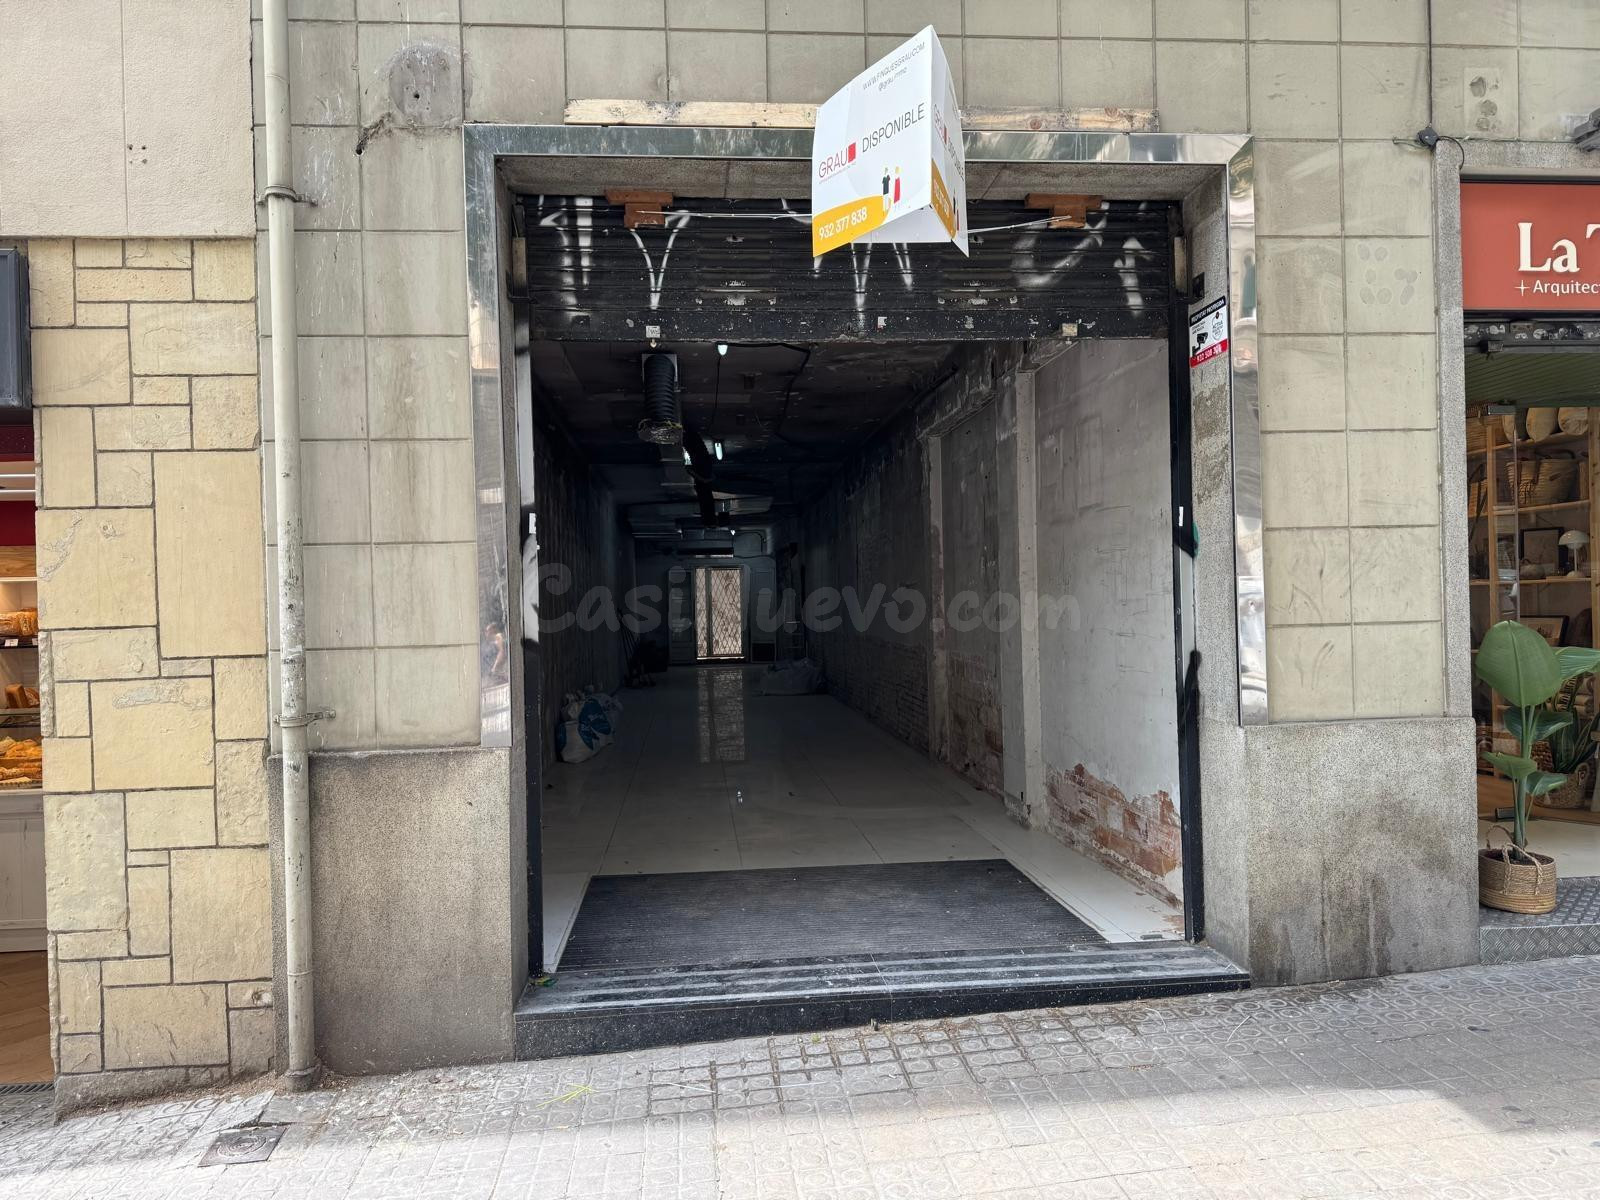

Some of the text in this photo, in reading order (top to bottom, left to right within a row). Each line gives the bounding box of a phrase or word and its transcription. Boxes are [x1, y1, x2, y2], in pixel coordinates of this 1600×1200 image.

[818, 147, 848, 179] GRAU
[862, 102, 925, 153] DISPONIBLE
[818, 205, 868, 241] 932 377 838
[1517, 222, 1580, 273] La
[1533, 279, 1600, 297] Arquitec
